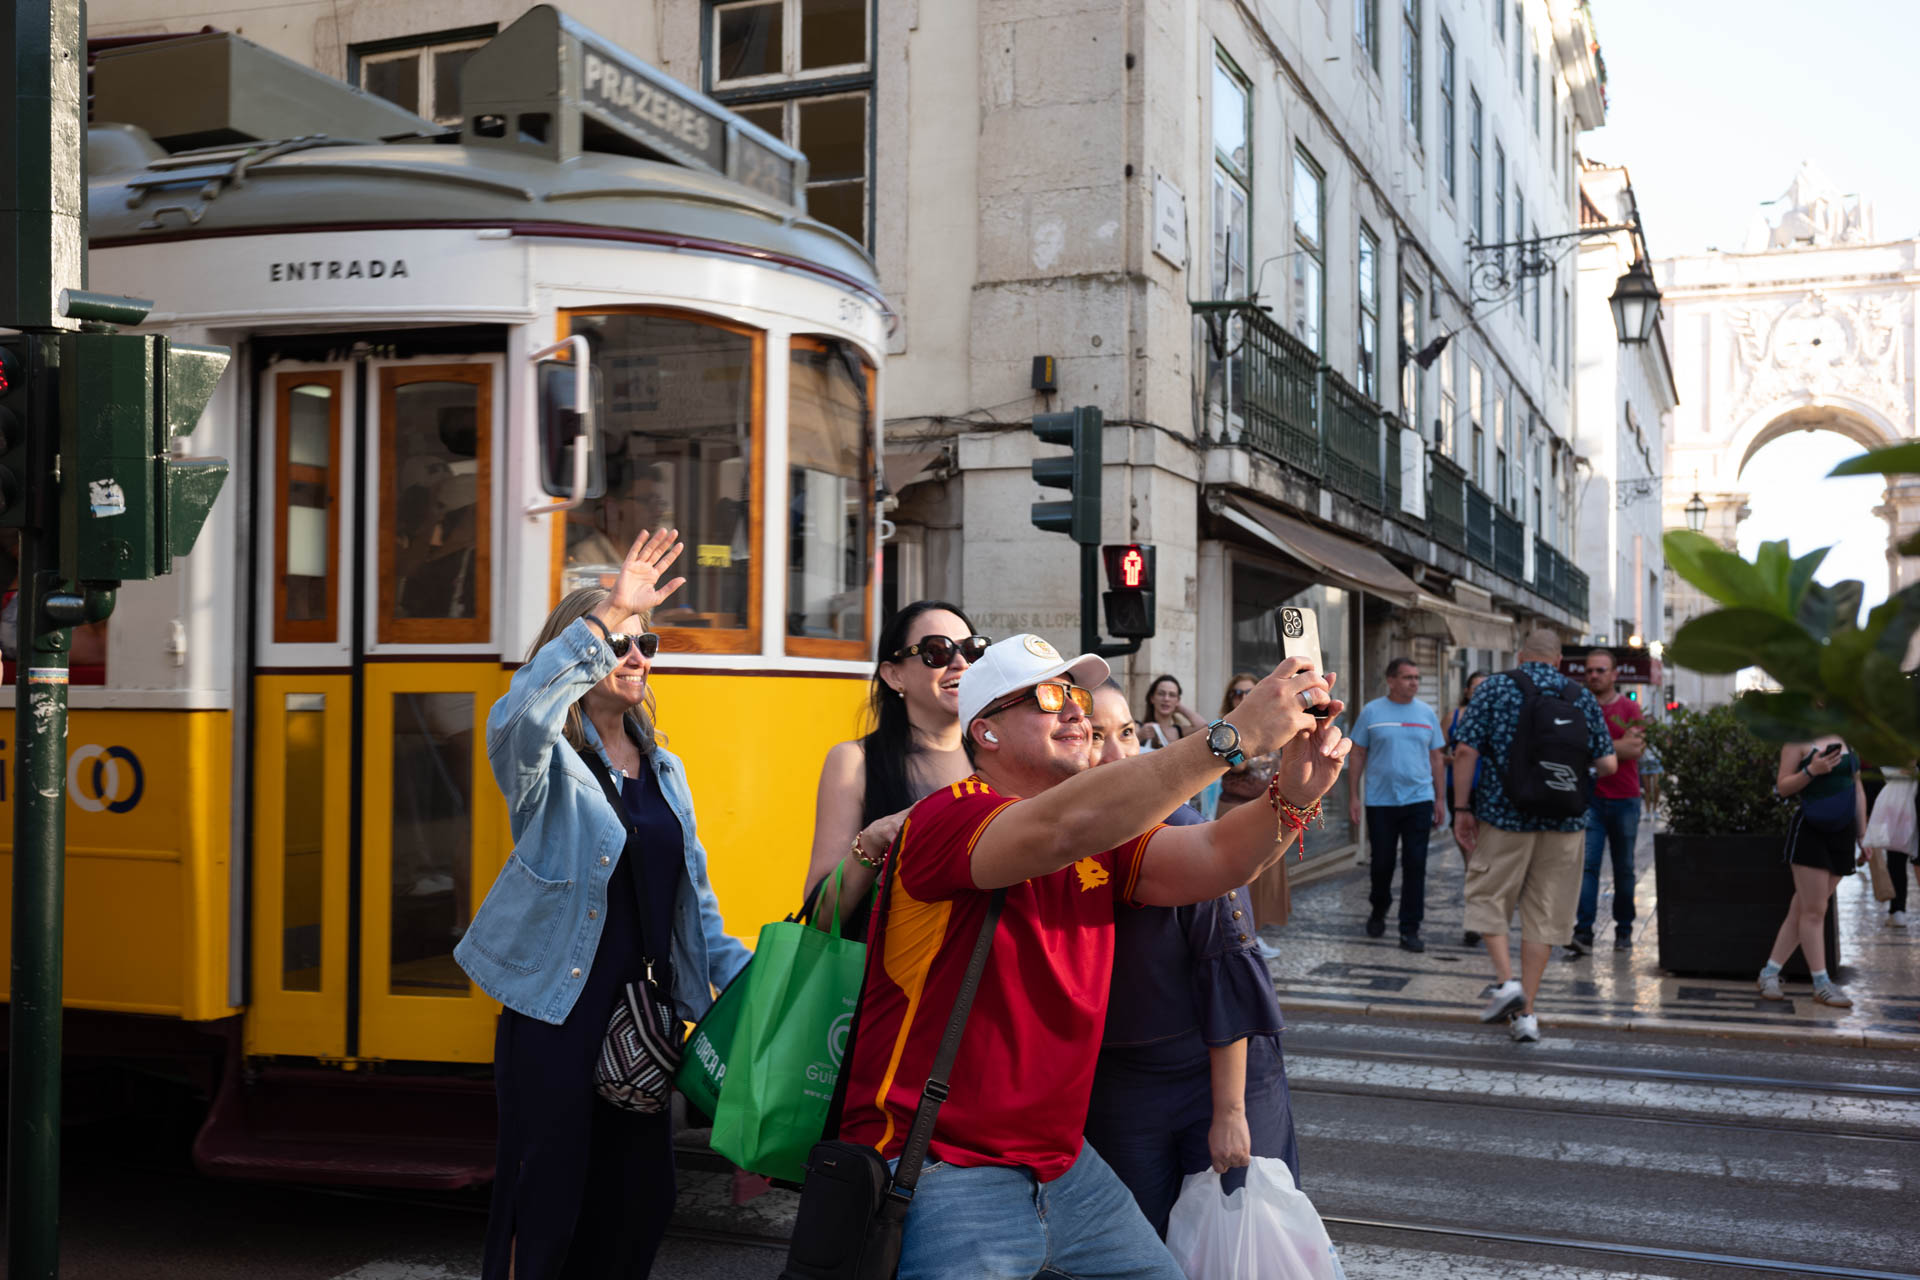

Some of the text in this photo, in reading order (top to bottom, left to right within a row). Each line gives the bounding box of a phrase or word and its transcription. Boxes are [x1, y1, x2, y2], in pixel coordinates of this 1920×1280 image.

[585, 53, 710, 151] PRAZERES
[269, 259, 409, 283] ENTRADA
[1031, 612, 1042, 629] &
[1045, 612, 1081, 629] LOPE
